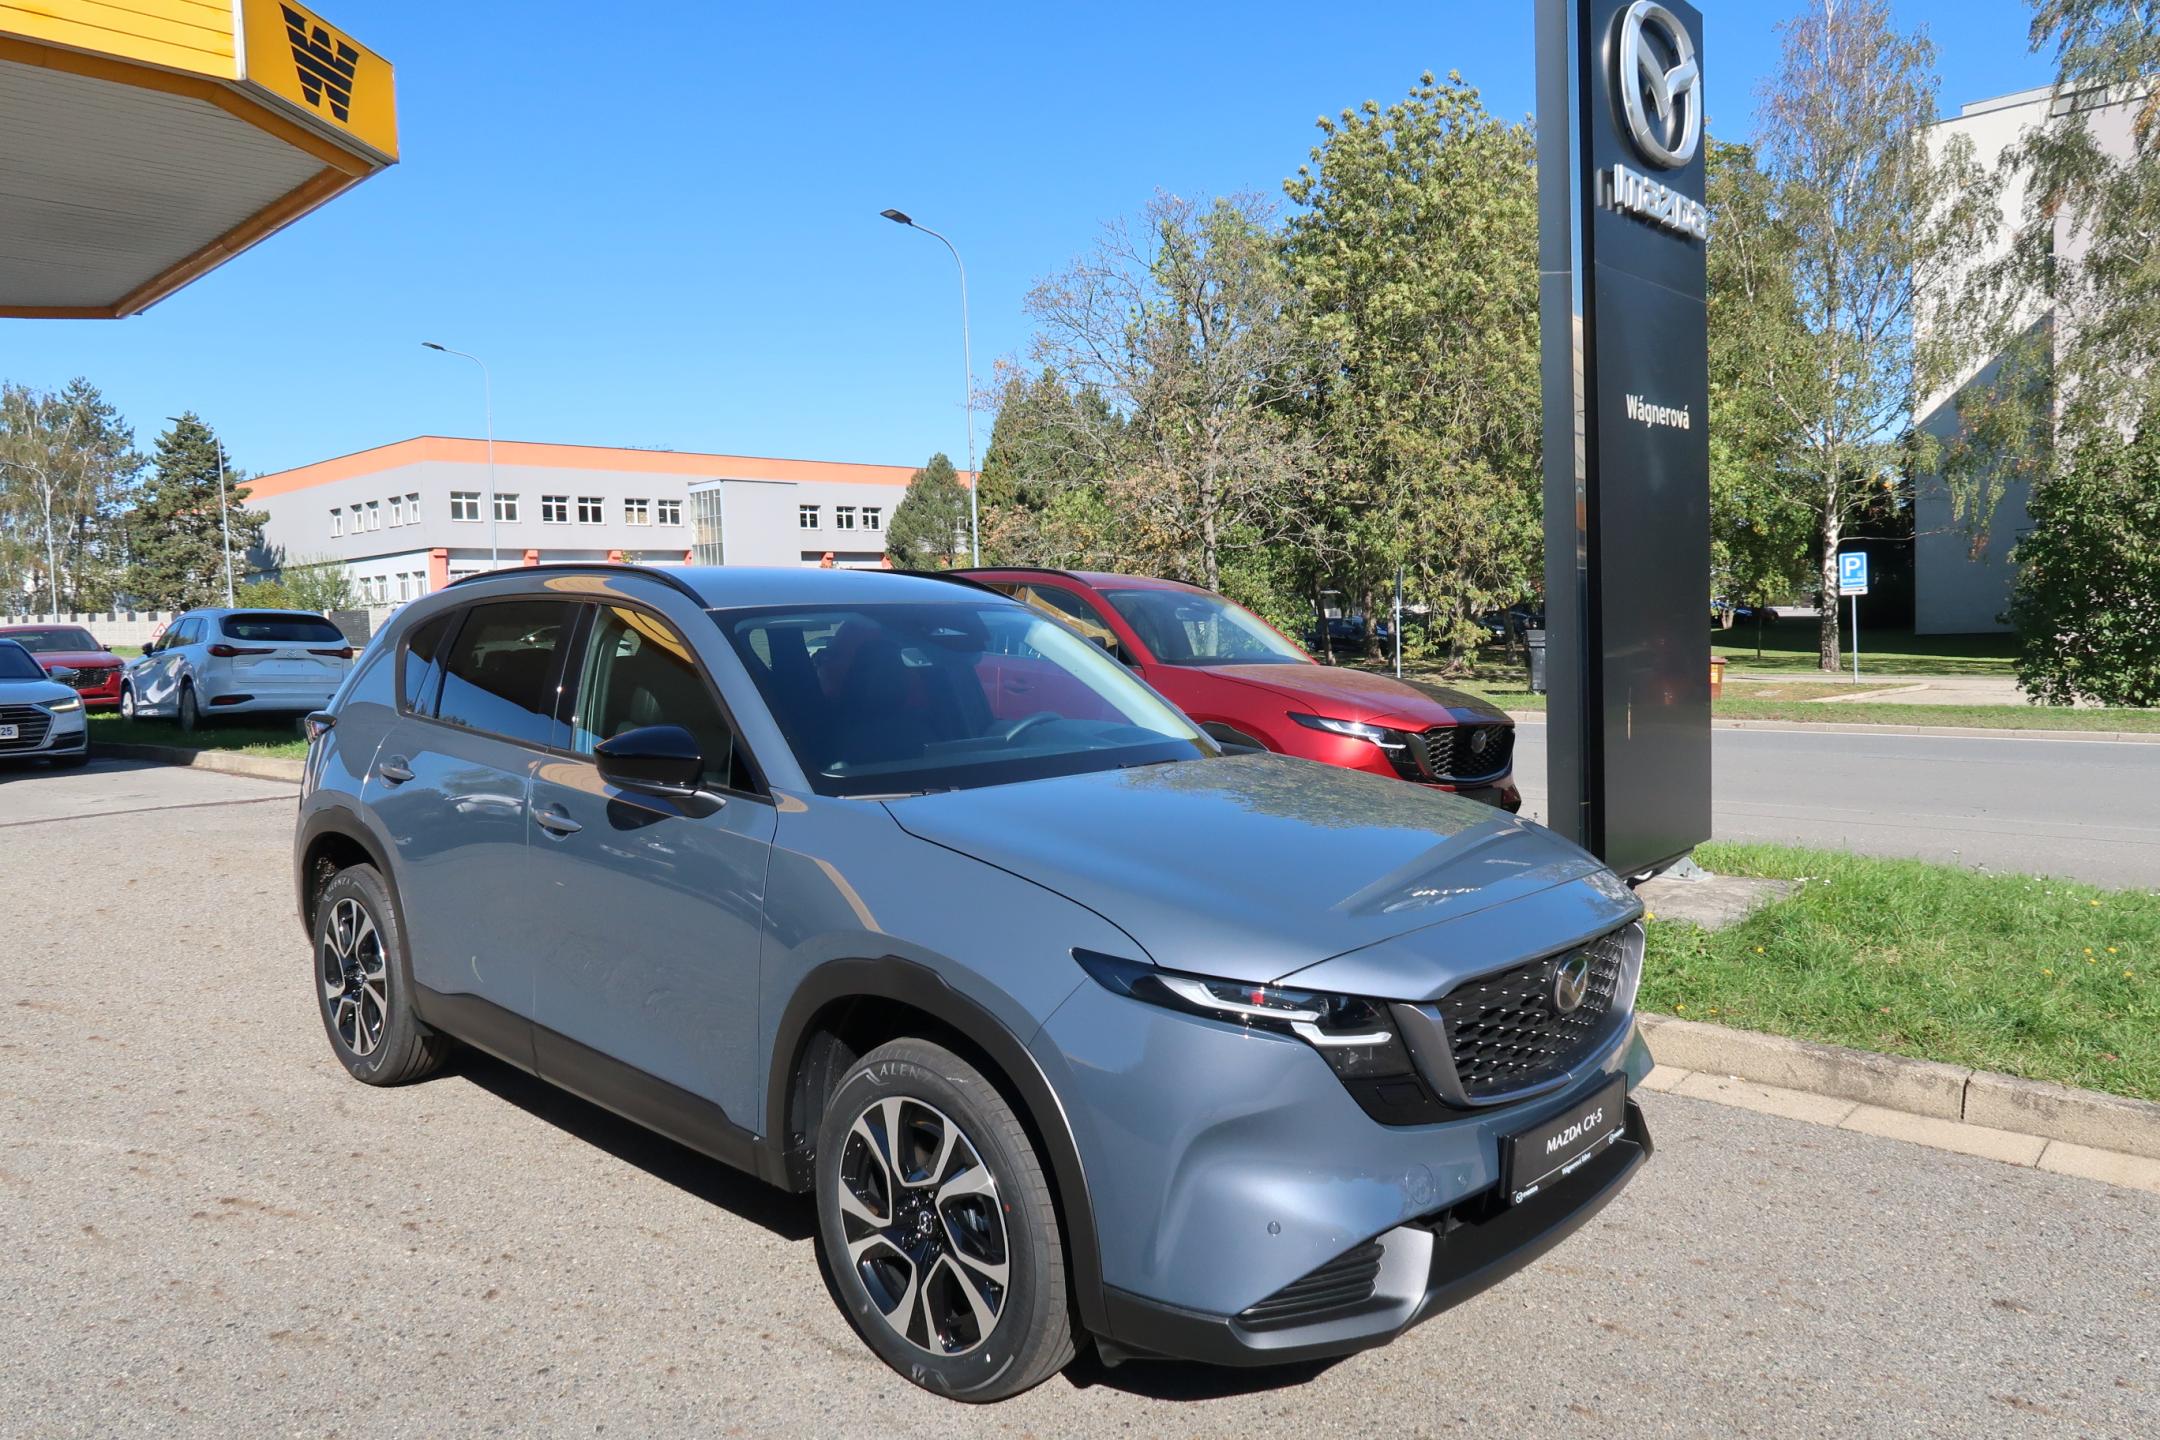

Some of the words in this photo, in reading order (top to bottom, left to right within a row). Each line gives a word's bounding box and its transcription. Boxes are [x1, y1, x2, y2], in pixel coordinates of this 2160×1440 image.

[279, 2, 359, 123] W
[1613, 163, 1707, 240] mazda
[1626, 393, 1690, 430] Wágnerová
[1844, 557, 1861, 577] P
[0, 726, 13, 736] 25
[1546, 1122, 1582, 1155] MAZDA
[1583, 1107, 1603, 1132] CX-5
